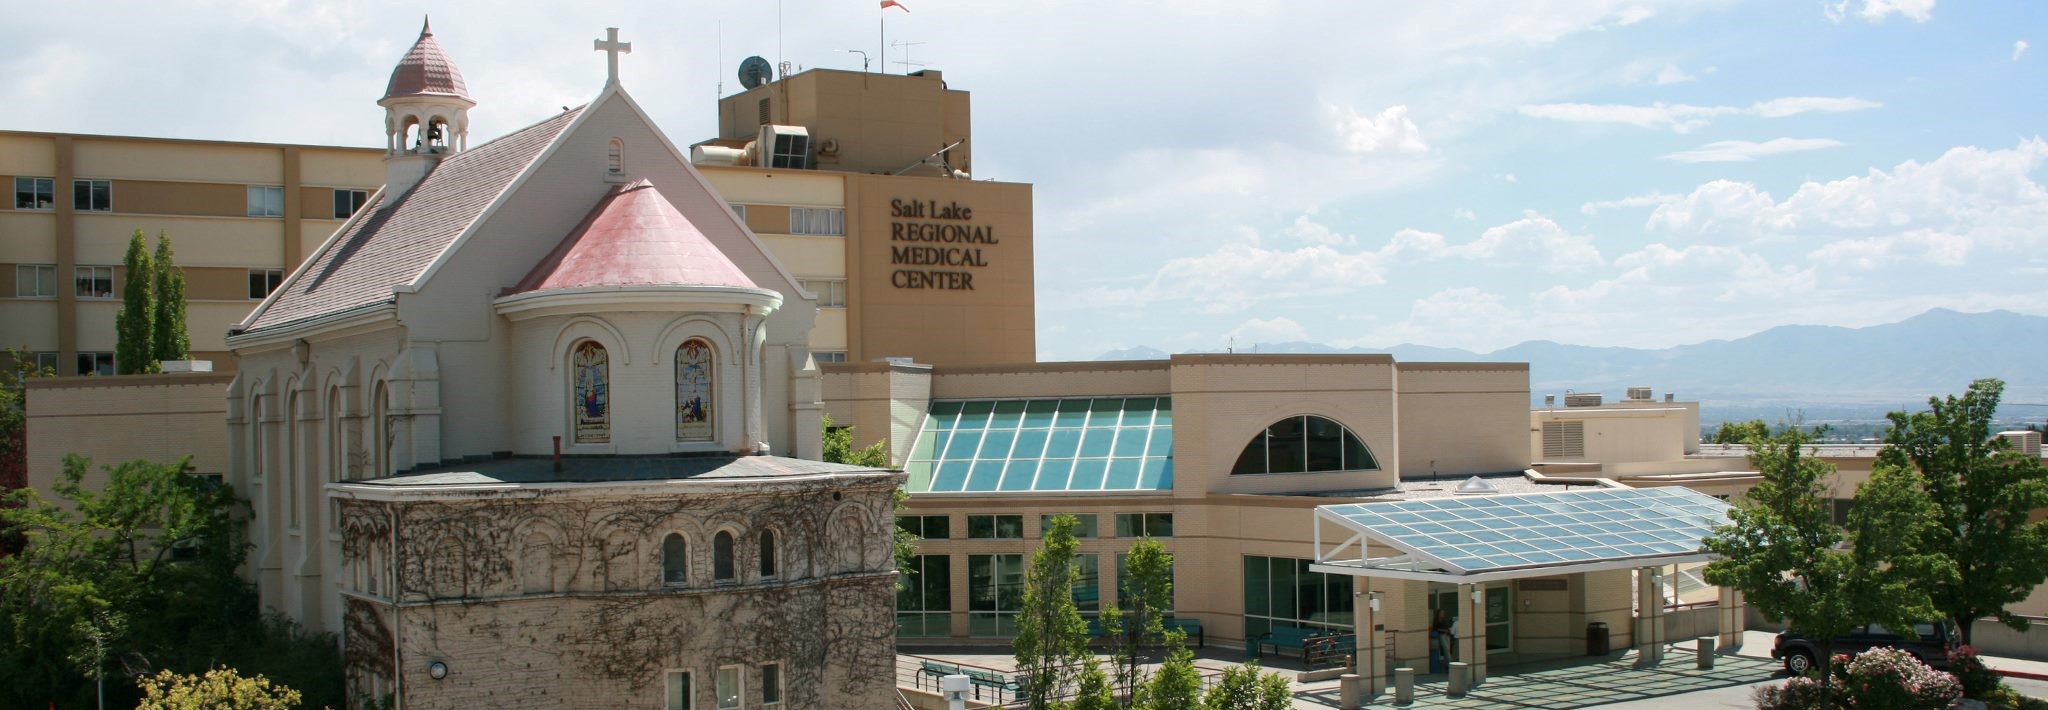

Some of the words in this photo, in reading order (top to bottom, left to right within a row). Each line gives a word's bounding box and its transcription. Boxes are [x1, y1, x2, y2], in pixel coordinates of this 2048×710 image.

[891, 199, 924, 218] Salt
[930, 200, 972, 220] Lake
[891, 222, 999, 244] REGIONAL
[891, 246, 988, 267] MEDICAL
[891, 270, 974, 290] CENTER
